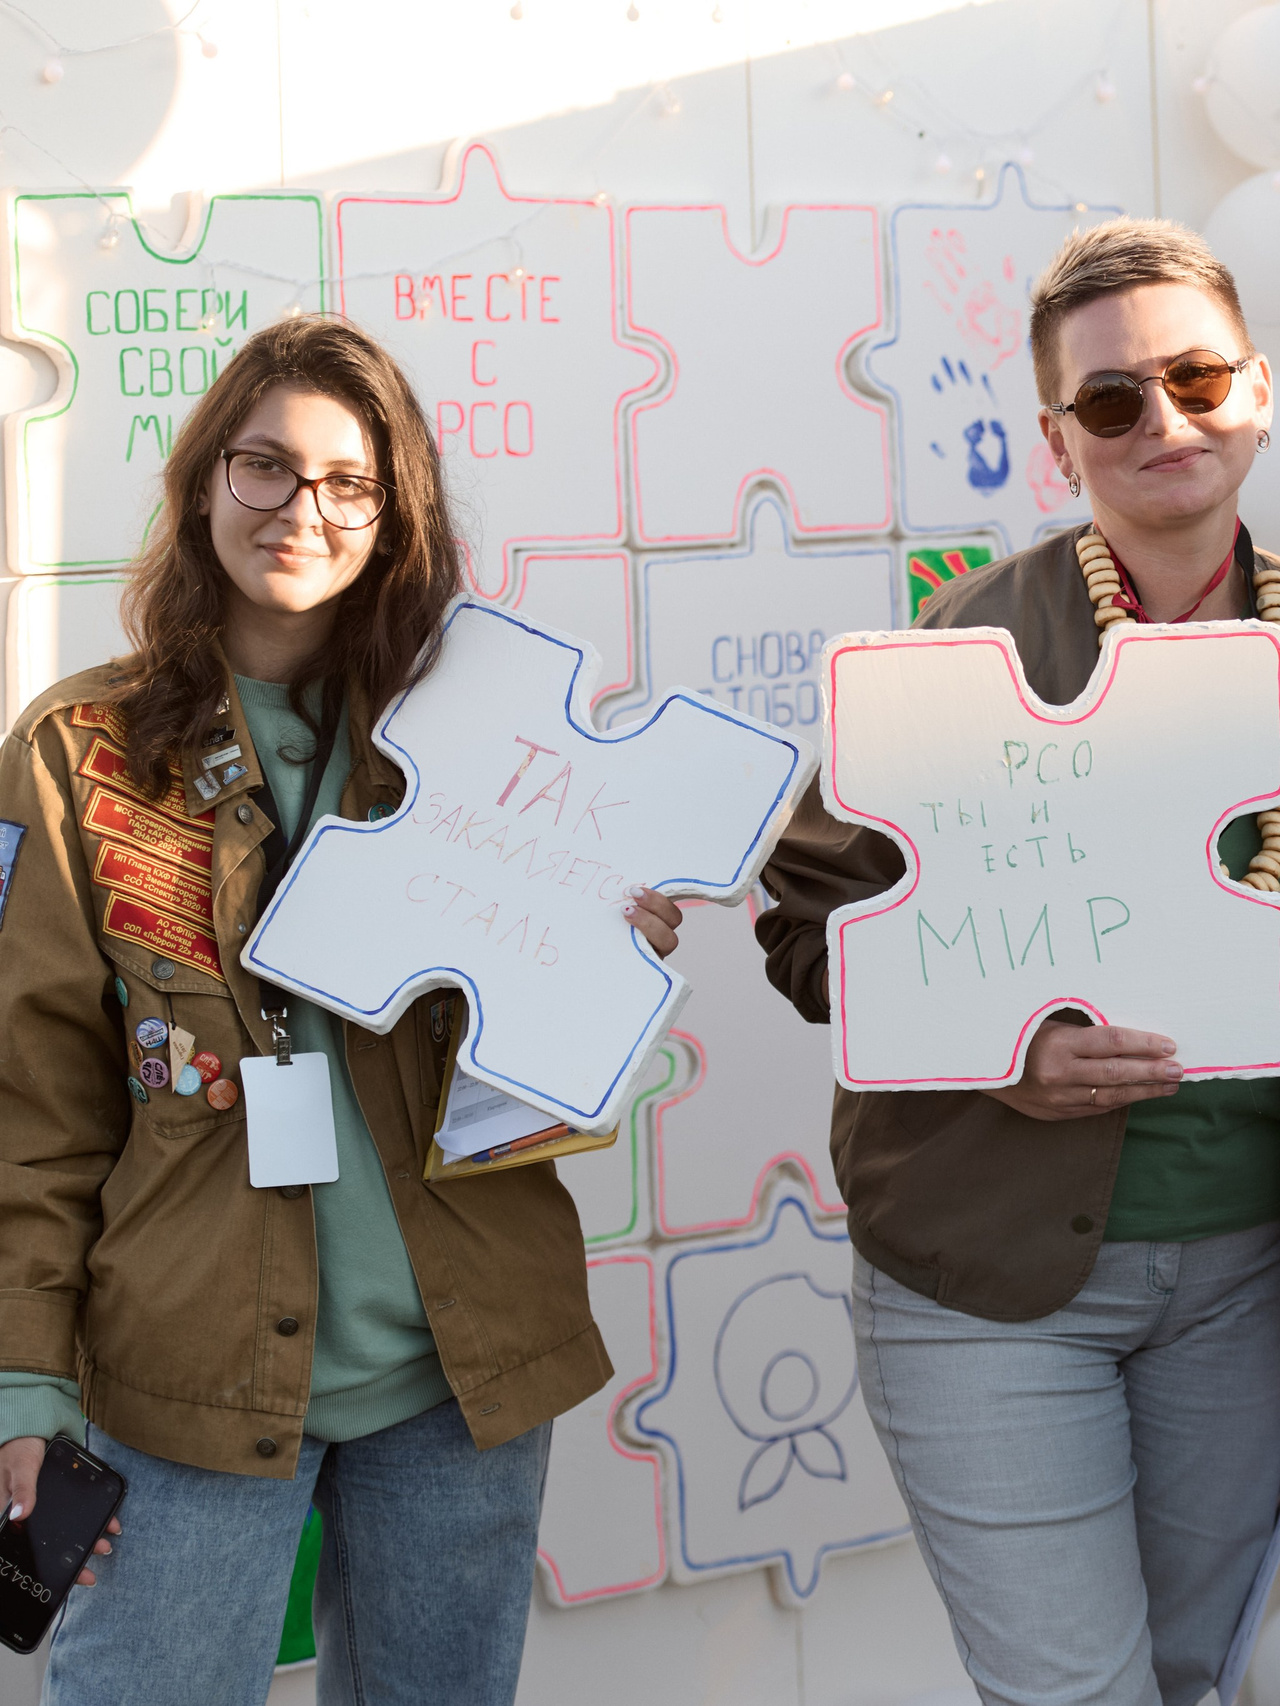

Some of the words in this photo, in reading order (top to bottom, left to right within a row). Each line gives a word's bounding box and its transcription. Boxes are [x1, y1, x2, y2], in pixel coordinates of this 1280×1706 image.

[86, 288, 248, 336] СОБЕРИ
[394, 273, 562, 323] ВМЕСТЕ
[470, 339, 499, 387] С
[436, 400, 534, 458] РСО
[711, 627, 827, 684] СНОВА
[1002, 739, 1093, 789] РСО
[495, 735, 630, 841] ТАК
[113, 804, 134, 818] МСС
[128, 819, 147, 832] ПАО
[918, 798, 987, 833] ТЫ
[1031, 799, 1050, 825] И
[113, 852, 127, 864] ИП
[128, 858, 152, 873] Глава
[132, 829, 157, 846] ЯНАО
[157, 840, 177, 853] 2021
[981, 832, 1087, 873] ЕСТЬ
[123, 874, 143, 887] ССО
[181, 899, 201, 912] 2020
[156, 918, 170, 929] АО
[171, 924, 197, 941] «ФПК»
[164, 931, 193, 948] Москва
[405, 873, 559, 967] СТАЛЬ
[916, 896, 1131, 986] МИР
[123, 922, 142, 935] СОП
[143, 929, 177, 951] «Перрон
[193, 951, 212, 965] 2019
